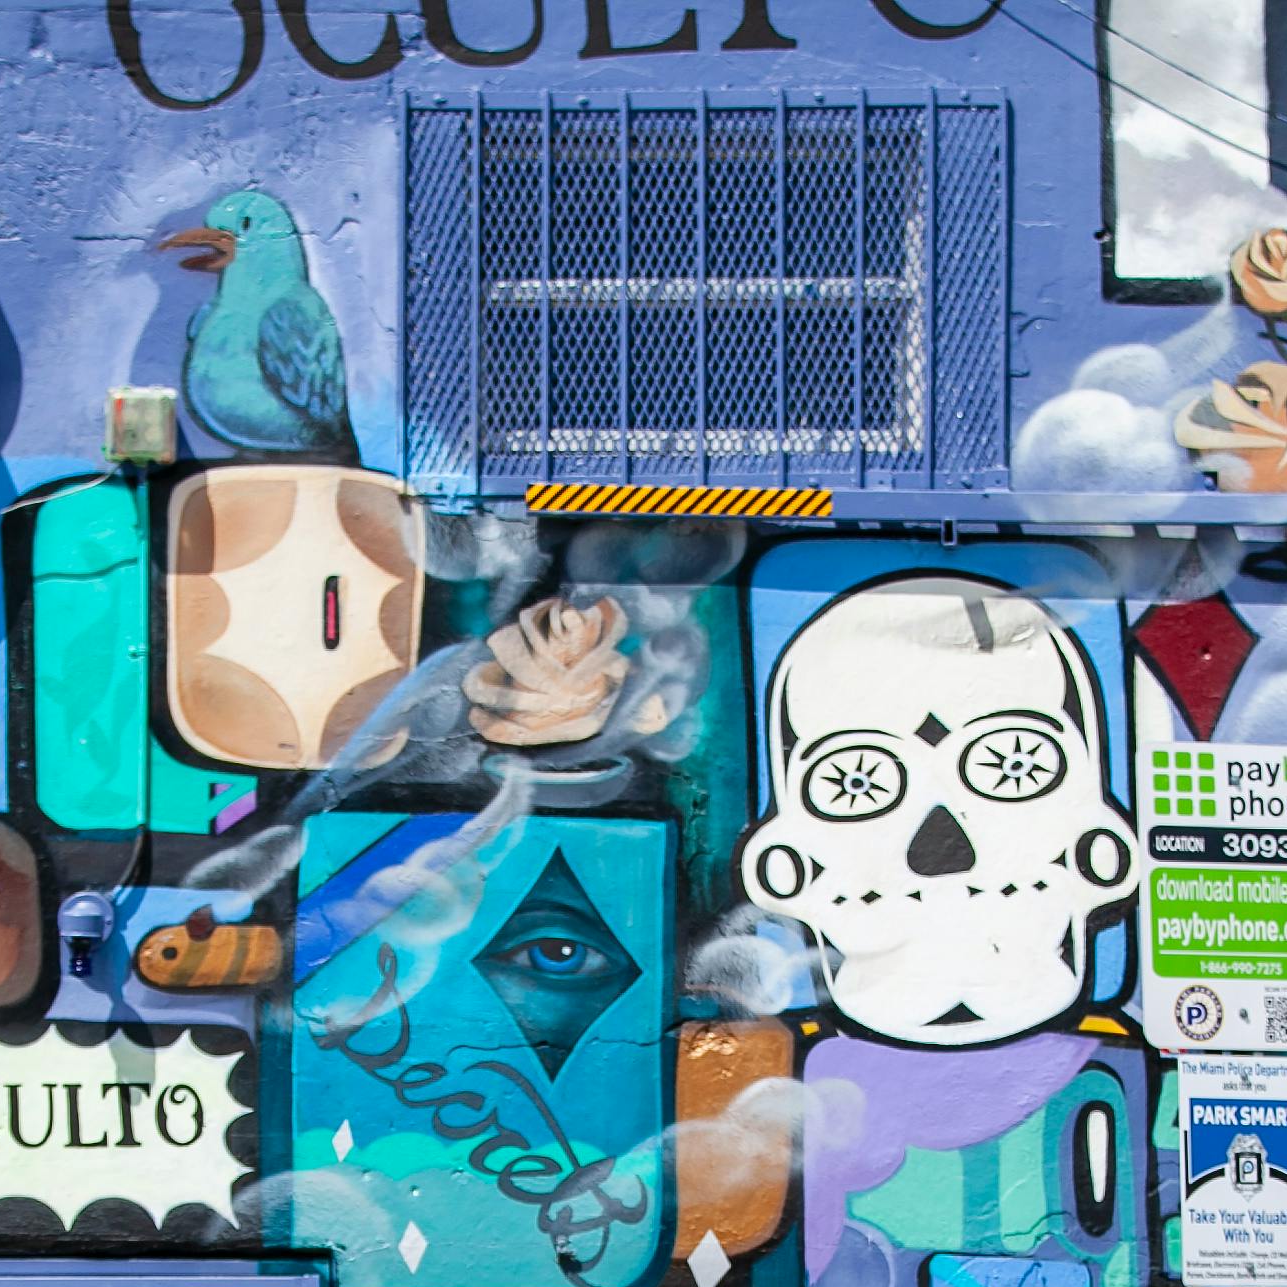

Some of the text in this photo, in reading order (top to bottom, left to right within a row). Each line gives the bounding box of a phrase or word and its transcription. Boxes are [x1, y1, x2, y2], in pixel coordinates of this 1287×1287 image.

[1155, 835, 1206, 853] LOCATION
[1156, 873, 1234, 902] download
[1182, 1060, 1197, 1074] The
[1200, 1062, 1226, 1075] Miami
[1228, 1063, 1253, 1077] Police
[1192, 1104, 1239, 1126] PARK
[1188, 1209, 1216, 1225] Take
[1218, 1209, 1246, 1225] Your
[1223, 1228, 1274, 1244] With You
